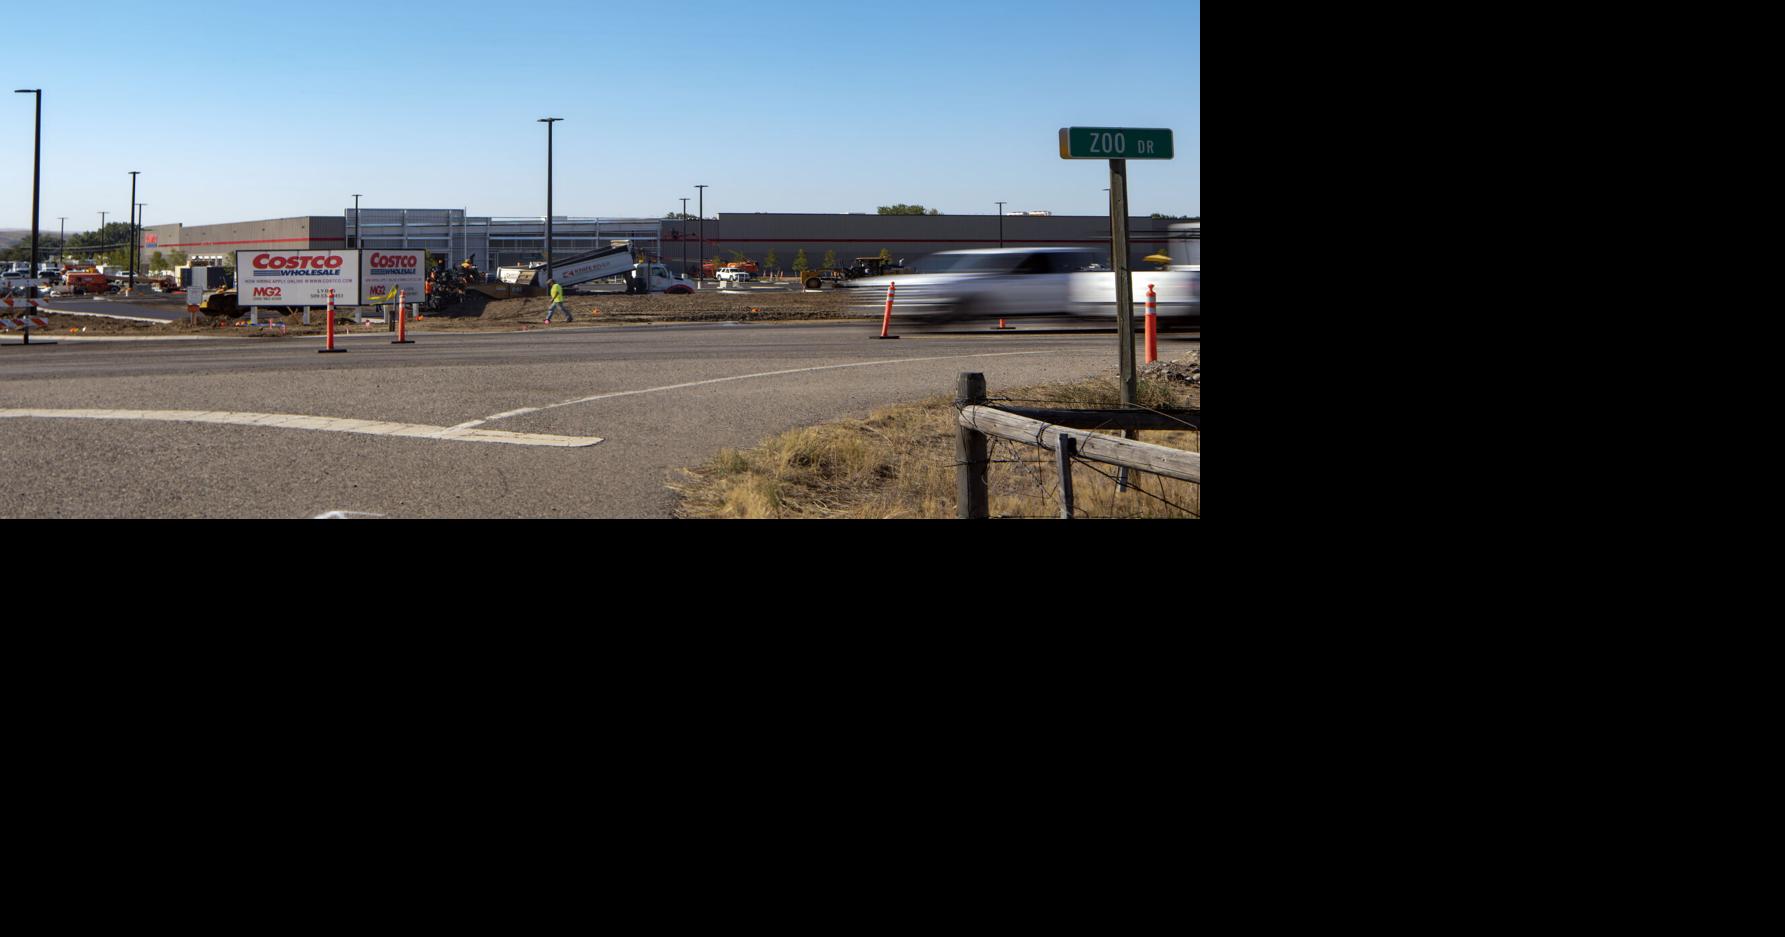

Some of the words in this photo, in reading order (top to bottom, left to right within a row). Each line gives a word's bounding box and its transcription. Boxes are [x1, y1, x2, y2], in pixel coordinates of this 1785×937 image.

[1089, 132, 1126, 154] ZOO
[1137, 139, 1154, 154] DR
[252, 253, 343, 269] COSTCO
[370, 252, 417, 268] COSTCO
[253, 286, 282, 297] MG2
